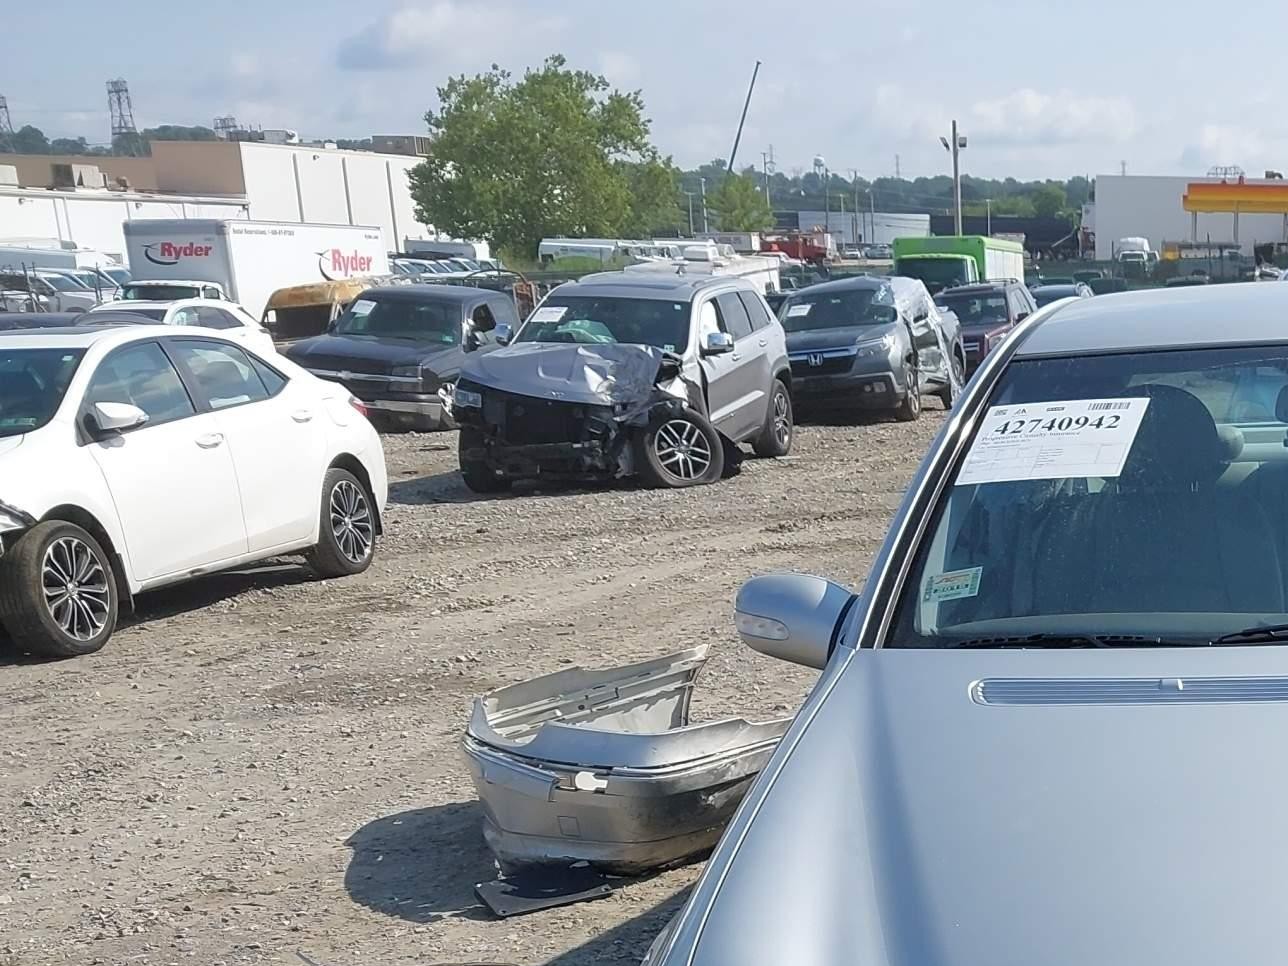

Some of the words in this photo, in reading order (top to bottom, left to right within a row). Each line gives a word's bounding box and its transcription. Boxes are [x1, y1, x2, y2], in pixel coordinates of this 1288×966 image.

[160, 241, 212, 260] Ryder
[331, 248, 373, 277] Ryder
[994, 415, 1121, 435] 42740942
